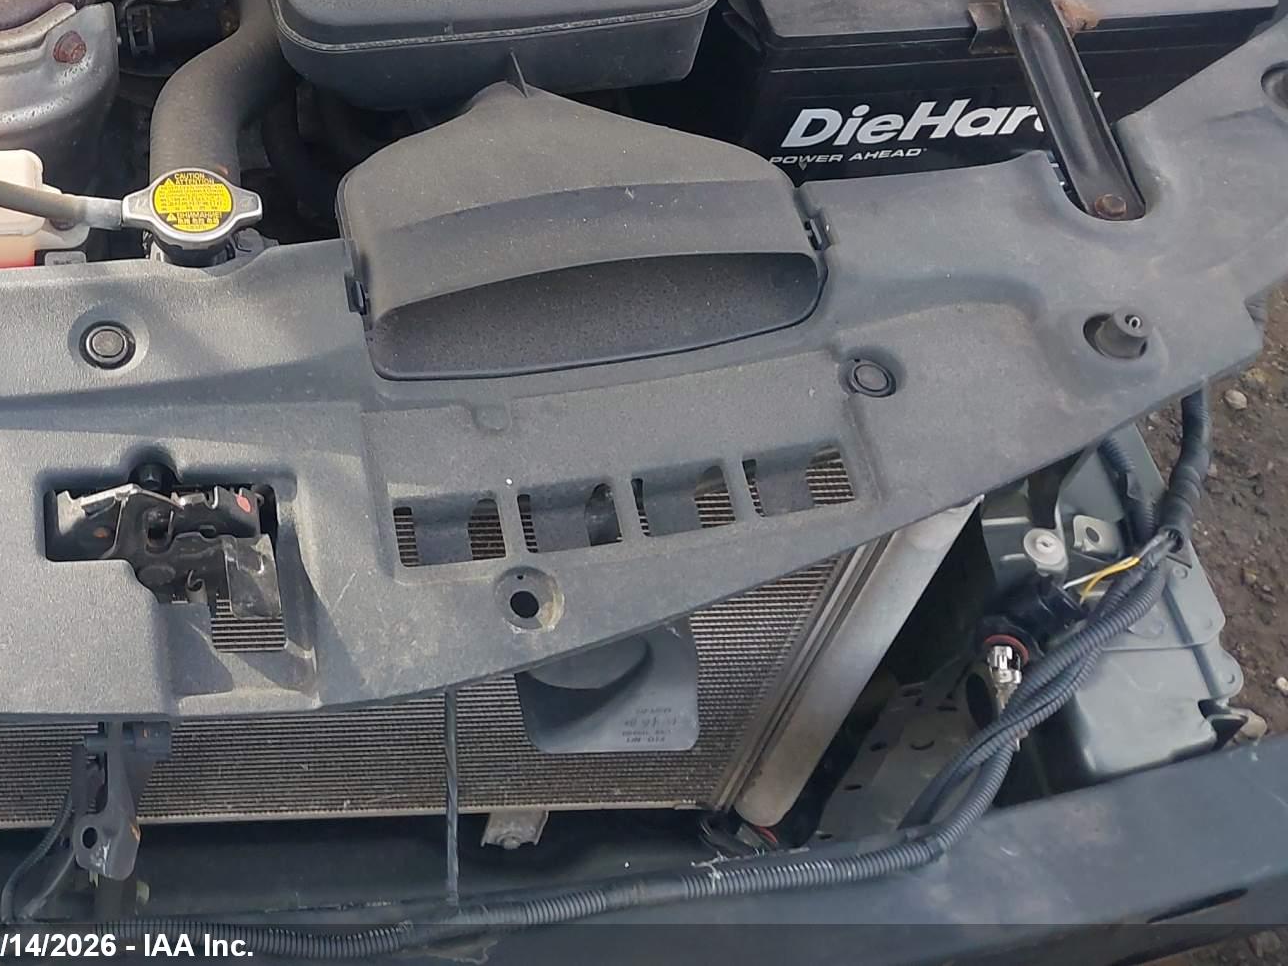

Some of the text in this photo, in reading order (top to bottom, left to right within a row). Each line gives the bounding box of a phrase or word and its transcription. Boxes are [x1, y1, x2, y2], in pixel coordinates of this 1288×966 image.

[780, 98, 1045, 148] DieHar
[768, 153, 844, 165] POWER
[175, 177, 216, 186] ATTENTION
